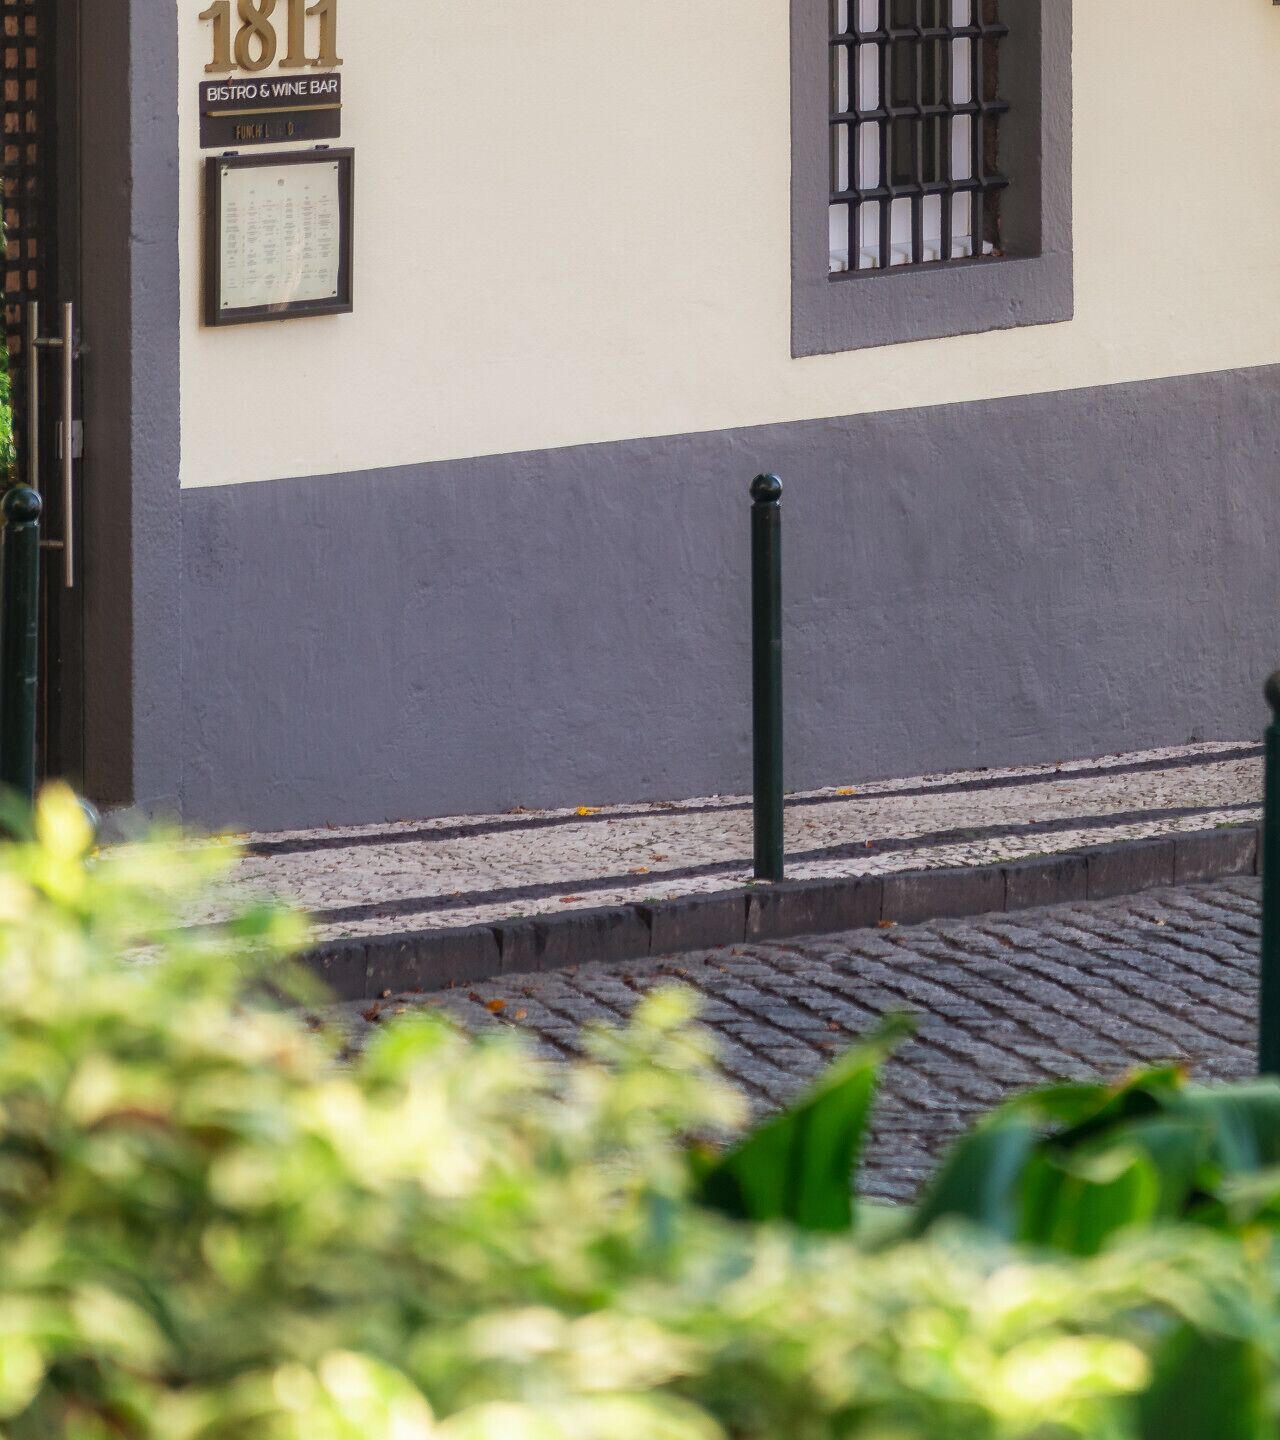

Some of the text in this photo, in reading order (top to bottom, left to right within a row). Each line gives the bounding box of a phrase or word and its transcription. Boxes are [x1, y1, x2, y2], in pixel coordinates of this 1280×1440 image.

[207, 79, 338, 101] BISTRO & WINE BAR
